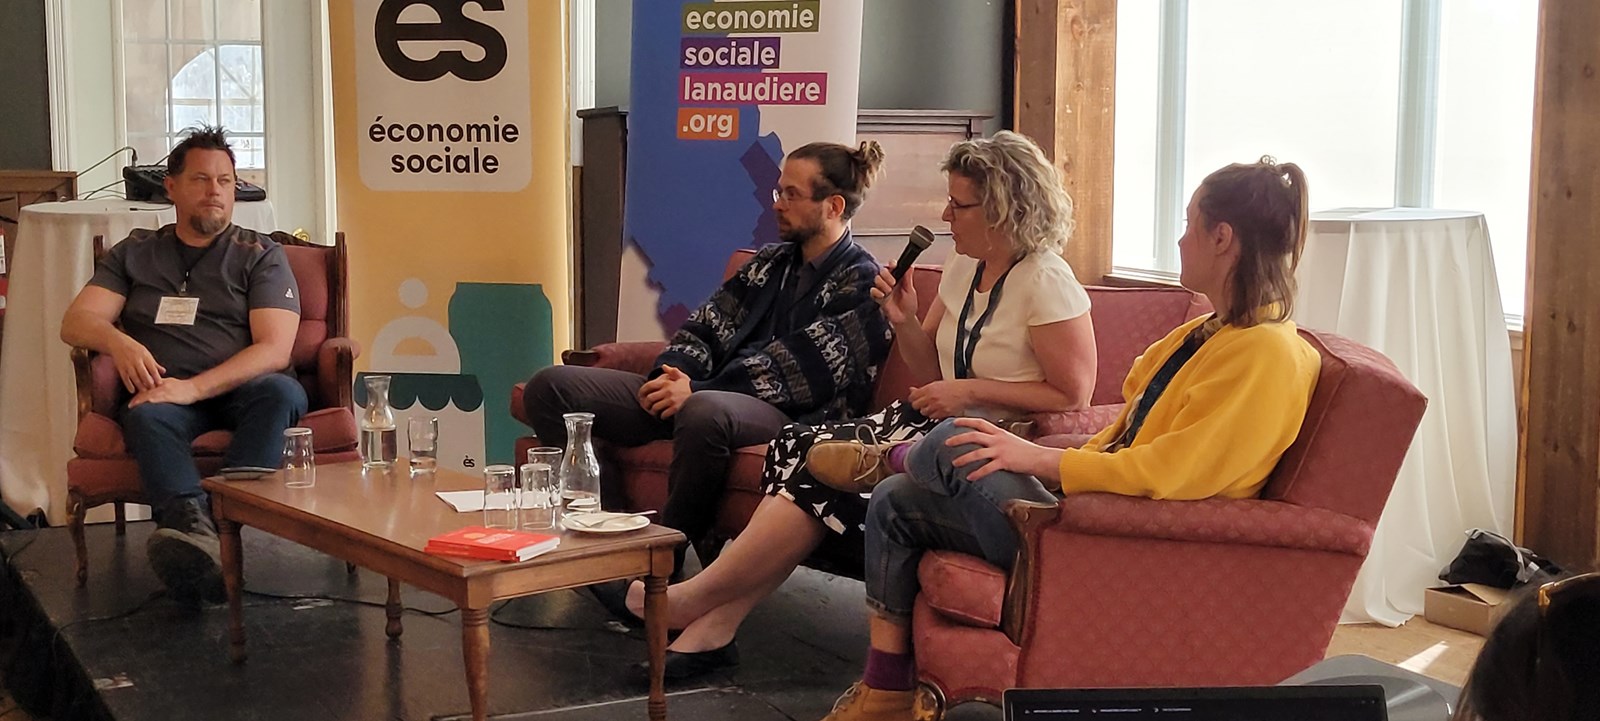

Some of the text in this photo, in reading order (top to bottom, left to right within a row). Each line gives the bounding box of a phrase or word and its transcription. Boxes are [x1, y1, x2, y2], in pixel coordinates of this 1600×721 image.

[685, 3, 815, 30] economie
[684, 41, 776, 66] sociale
[684, 76, 821, 102] lanaudiere
[368, 115, 520, 143] économie
[682, 112, 733, 138] .org
[390, 146, 499, 174] sociale
